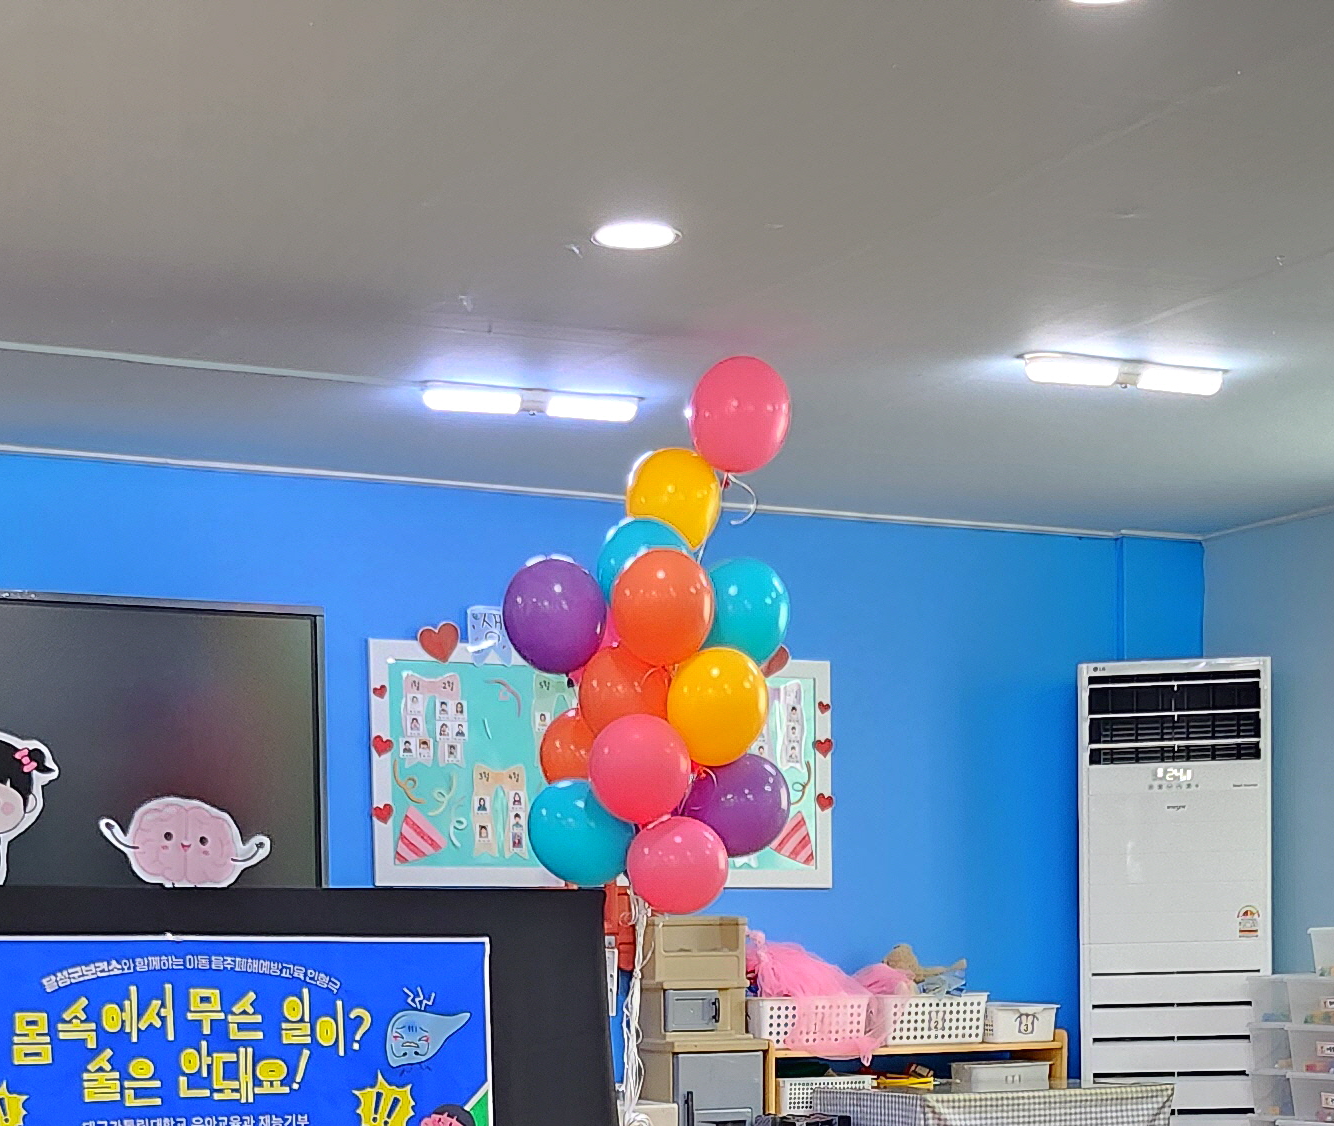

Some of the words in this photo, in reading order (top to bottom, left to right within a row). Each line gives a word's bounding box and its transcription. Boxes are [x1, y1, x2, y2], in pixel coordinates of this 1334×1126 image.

[41, 959, 134, 992] 달성군보건소와
[135, 955, 184, 973] 함께하는
[186, 955, 209, 970] 이동
[305, 969, 341, 994] 인형극
[12, 1011, 53, 1065] 몸
[57, 982, 174, 1049] 속에서
[186, 987, 264, 1041] 무슨
[281, 987, 372, 1056] 일이?
[933, 1020, 939, 1030] 2
[1023, 1023, 1029, 1033] 3
[82, 1048, 162, 1106] 술은
[178, 1040, 311, 1103] 안돼요!
